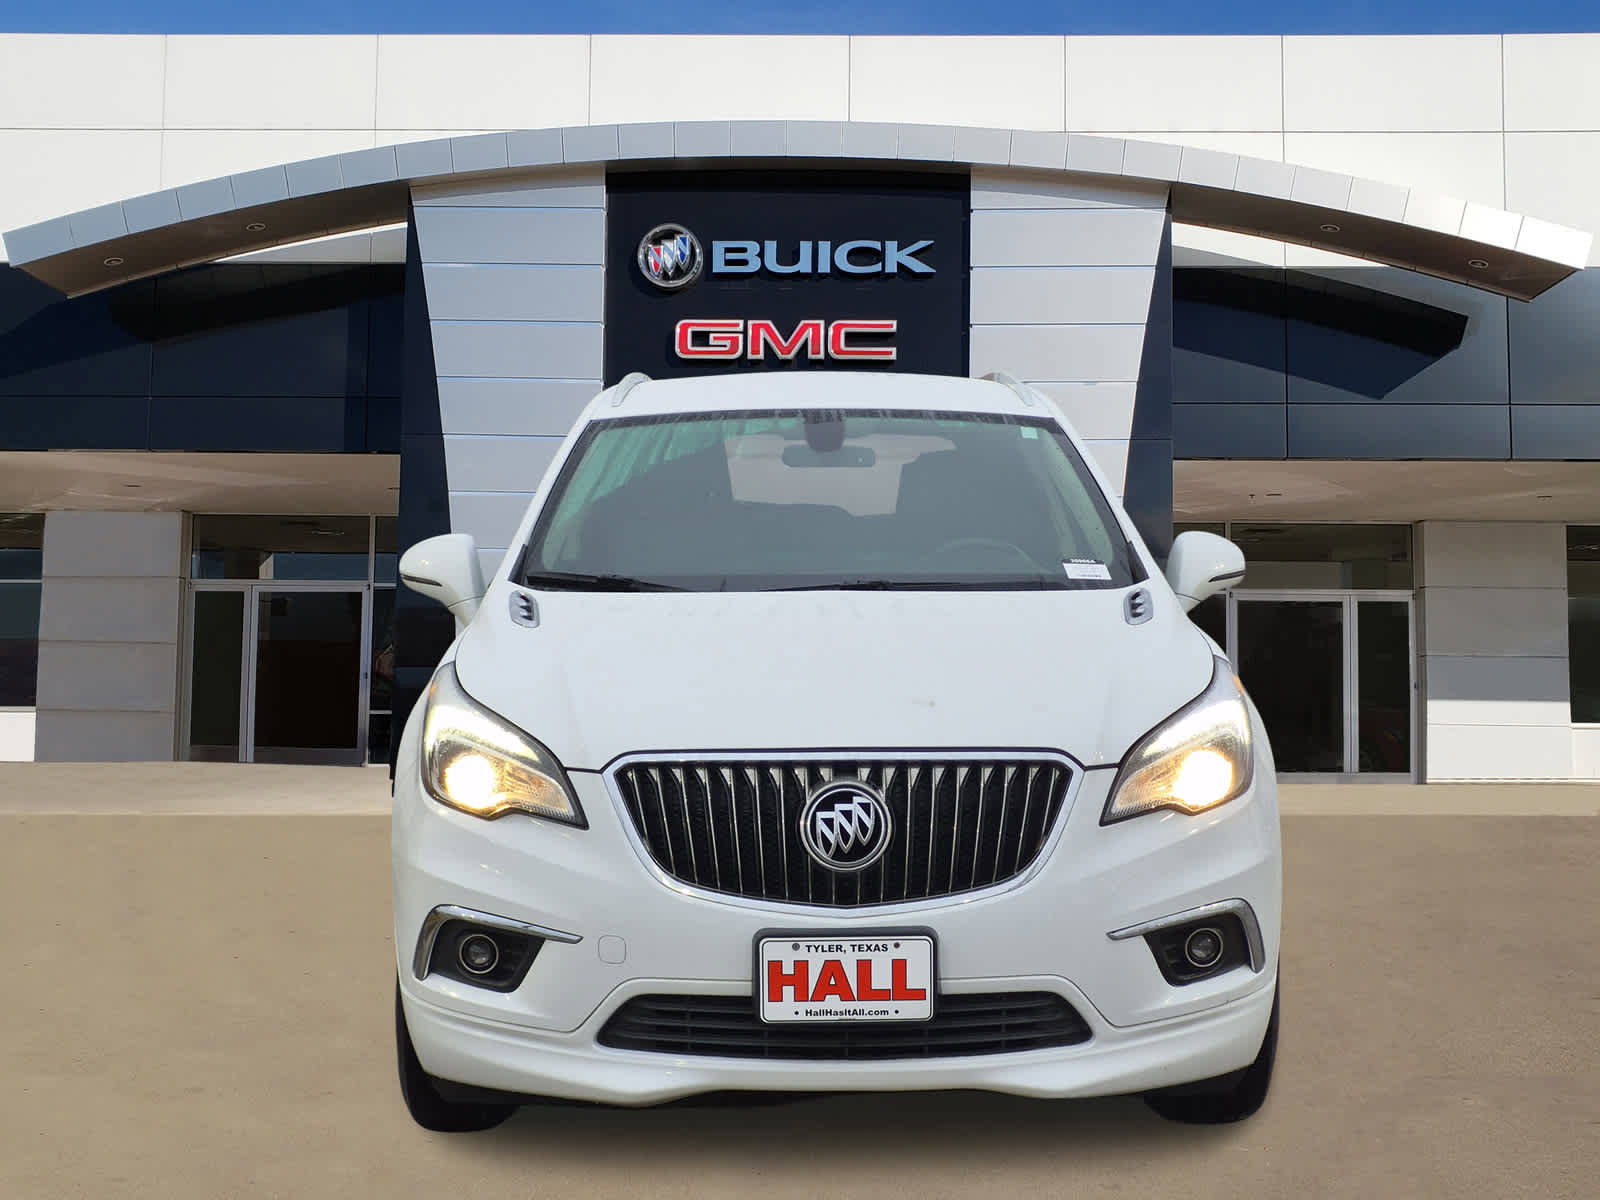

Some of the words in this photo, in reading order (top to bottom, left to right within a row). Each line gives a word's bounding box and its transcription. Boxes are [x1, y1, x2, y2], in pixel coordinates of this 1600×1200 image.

[711, 240, 936, 273] BUICK
[674, 319, 897, 360] GMC
[805, 944, 847, 954] TYLER,
[850, 943, 889, 952] TEXAS
[767, 959, 926, 1002] HALL
[805, 1008, 889, 1017] HallHasItAll.com
